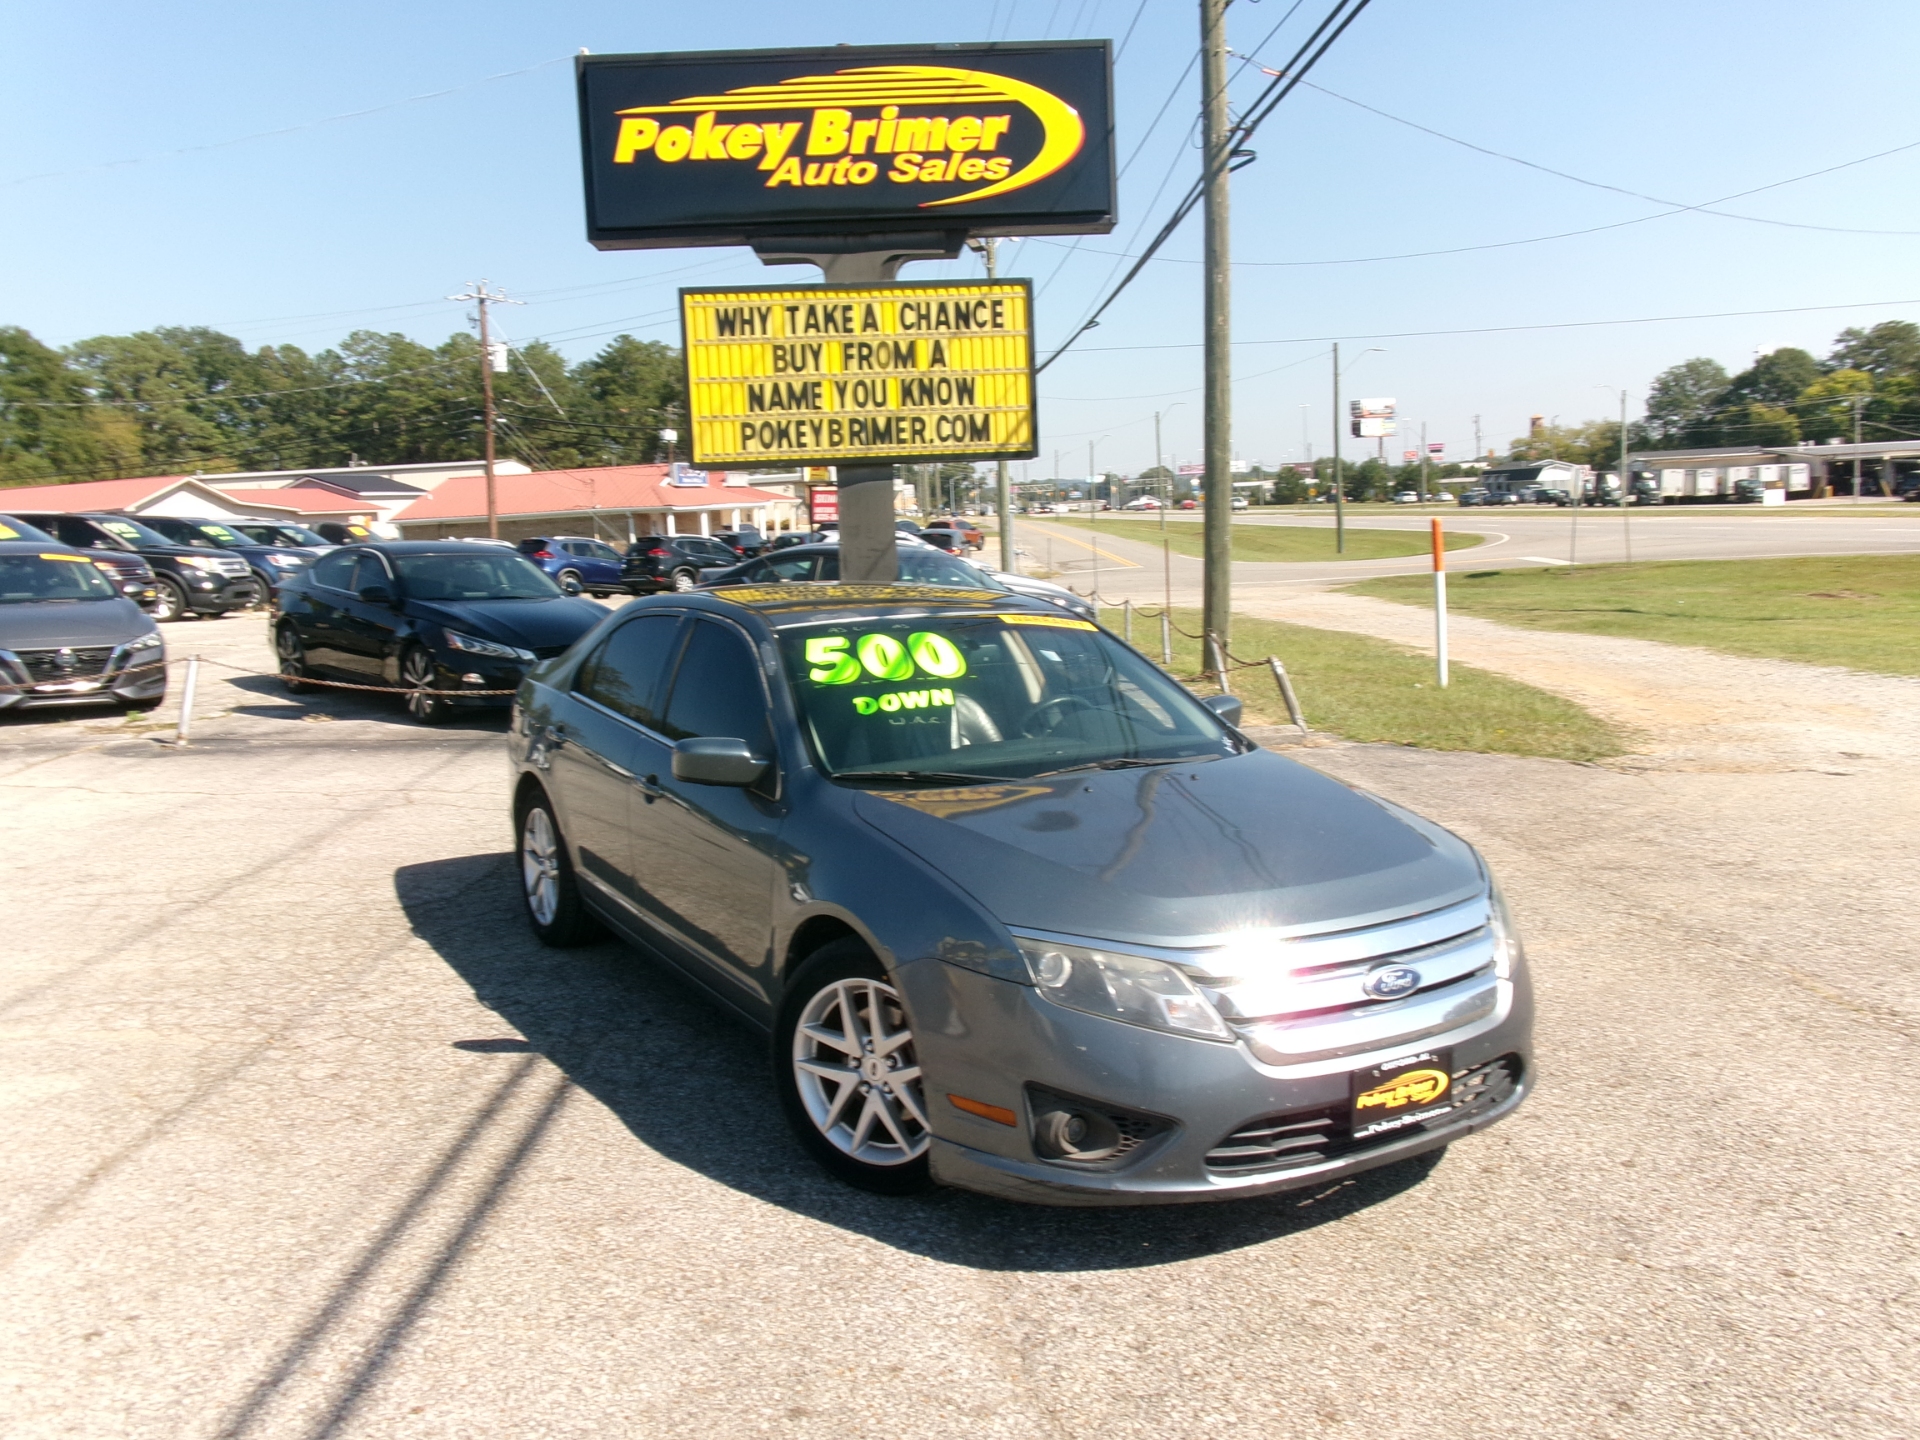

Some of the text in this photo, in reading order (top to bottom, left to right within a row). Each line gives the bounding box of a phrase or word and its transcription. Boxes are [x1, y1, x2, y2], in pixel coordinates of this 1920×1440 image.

[614, 106, 1010, 170] Pokey Brimer
[765, 152, 1012, 187] Auto Sales
[715, 299, 1004, 337] WHY TAKE A CHANCE
[773, 339, 947, 373] BUY FROM A
[748, 377, 976, 412] NAME YOU KNOW
[741, 413, 991, 450] POKEYBRIMER.COM
[805, 632, 967, 685] 500
[852, 688, 954, 715] DOWN
[1381, 971, 1412, 991] Ford
